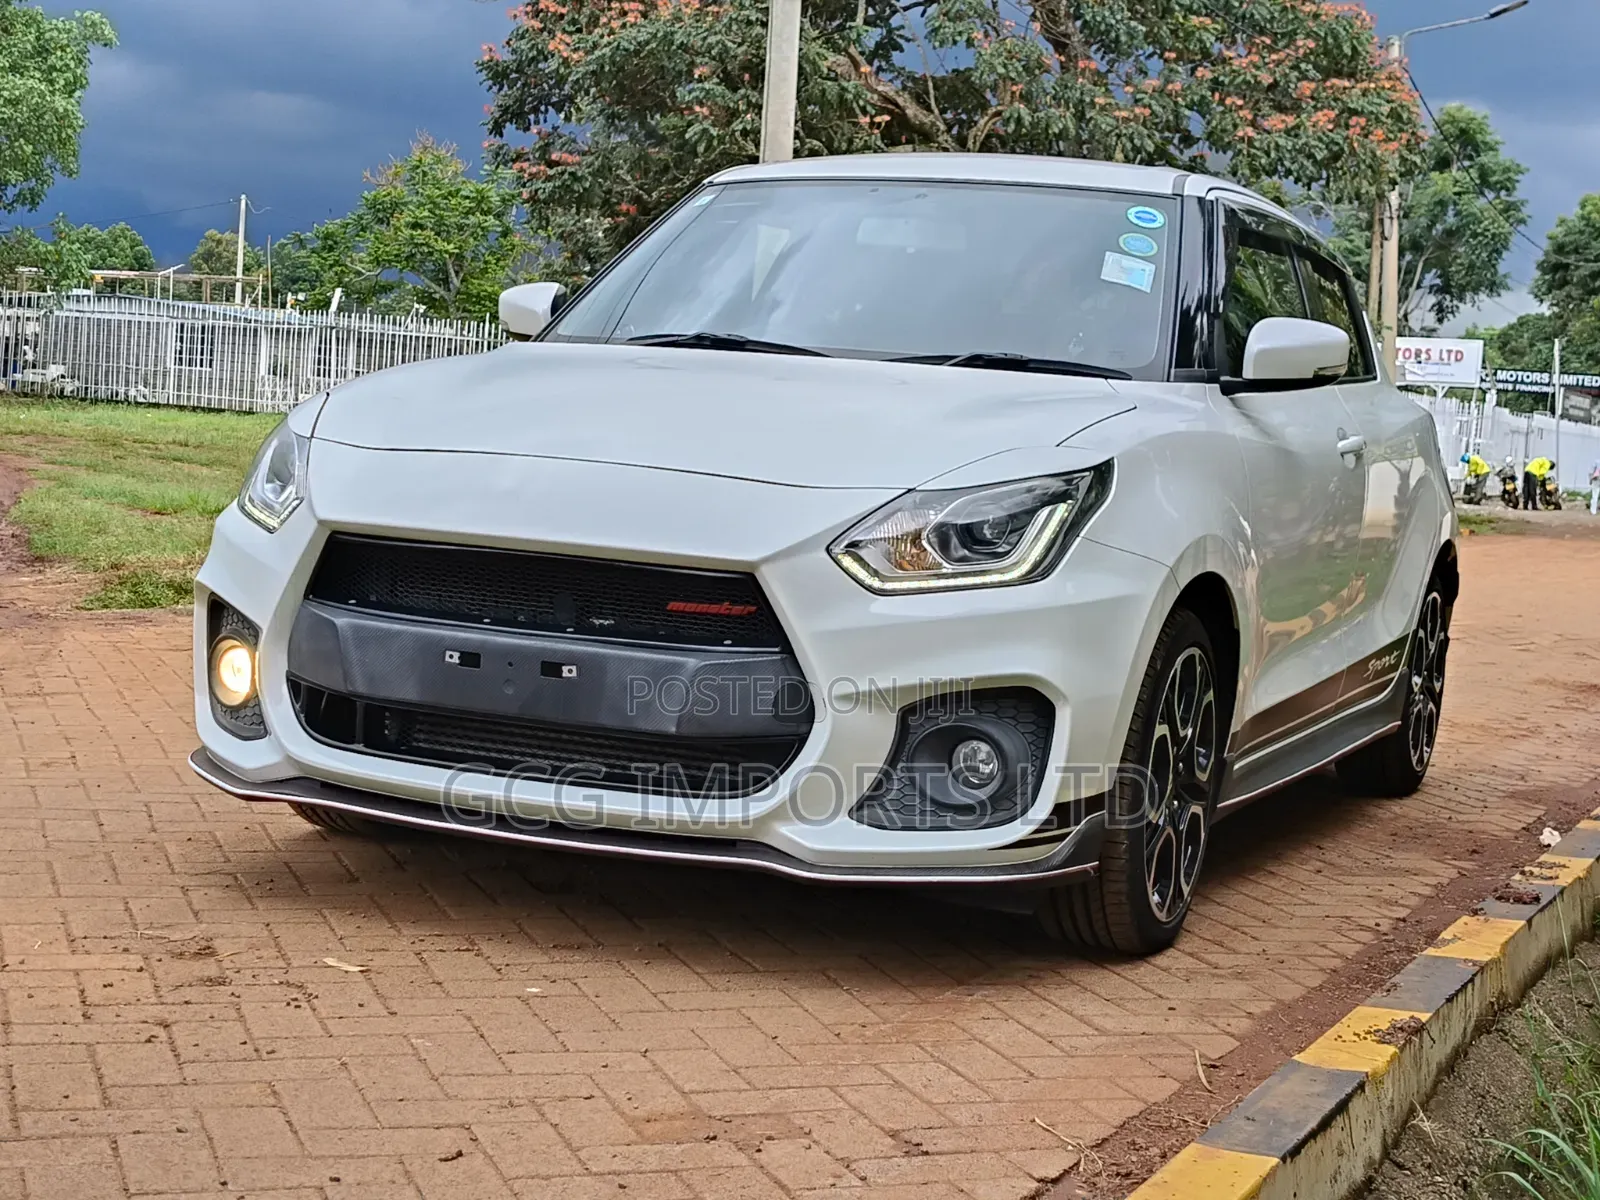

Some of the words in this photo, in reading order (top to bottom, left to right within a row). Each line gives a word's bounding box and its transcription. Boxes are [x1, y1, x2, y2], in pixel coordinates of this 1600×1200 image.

[1439, 348, 1464, 362] LTD
[1496, 369, 1550, 384] MOTORS
[1363, 650, 1400, 680] Sport
